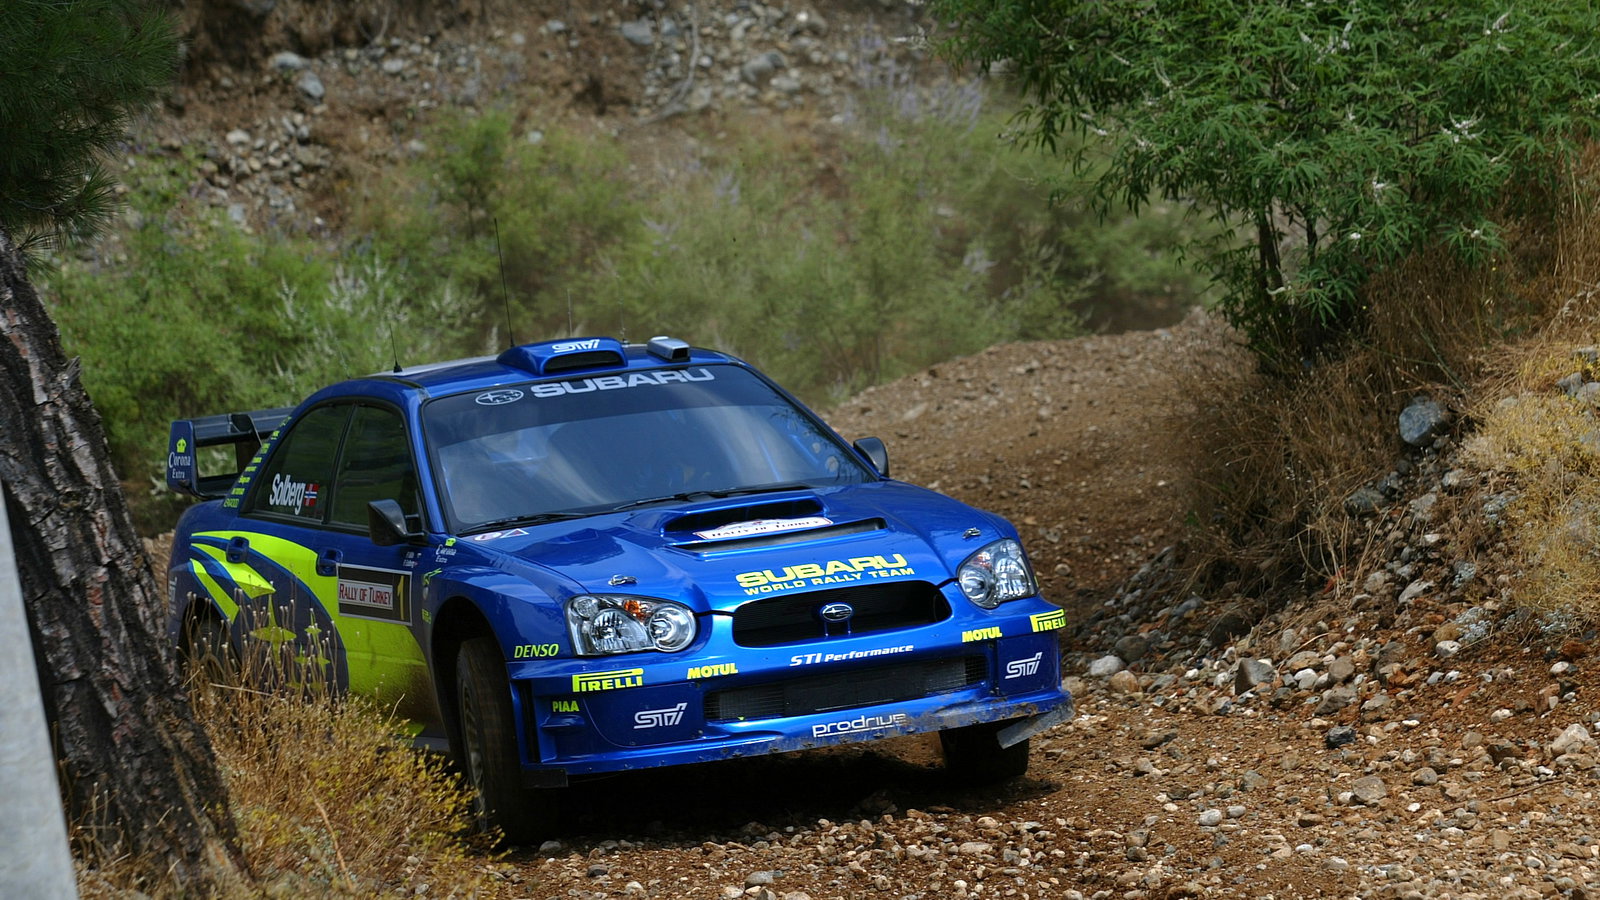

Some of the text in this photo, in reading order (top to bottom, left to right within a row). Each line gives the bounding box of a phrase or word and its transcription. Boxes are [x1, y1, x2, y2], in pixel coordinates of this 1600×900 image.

[531, 369, 715, 399] SUBARU
[169, 451, 191, 468] Corona
[269, 472, 306, 515] Solberg
[735, 553, 908, 588] SUBARU
[744, 567, 915, 596] WORLD RALLY TEAM
[339, 583, 392, 605] RALLY OF TURKEY
[397, 574, 405, 621] 1
[961, 626, 1003, 643] MOTUL
[514, 643, 560, 659] DENSO
[790, 644, 914, 667] STI Performance
[572, 667, 644, 693] PIRELLI
[687, 663, 739, 680] MOTUL
[552, 700, 580, 713] PIAA
[812, 713, 906, 738] prodrive
